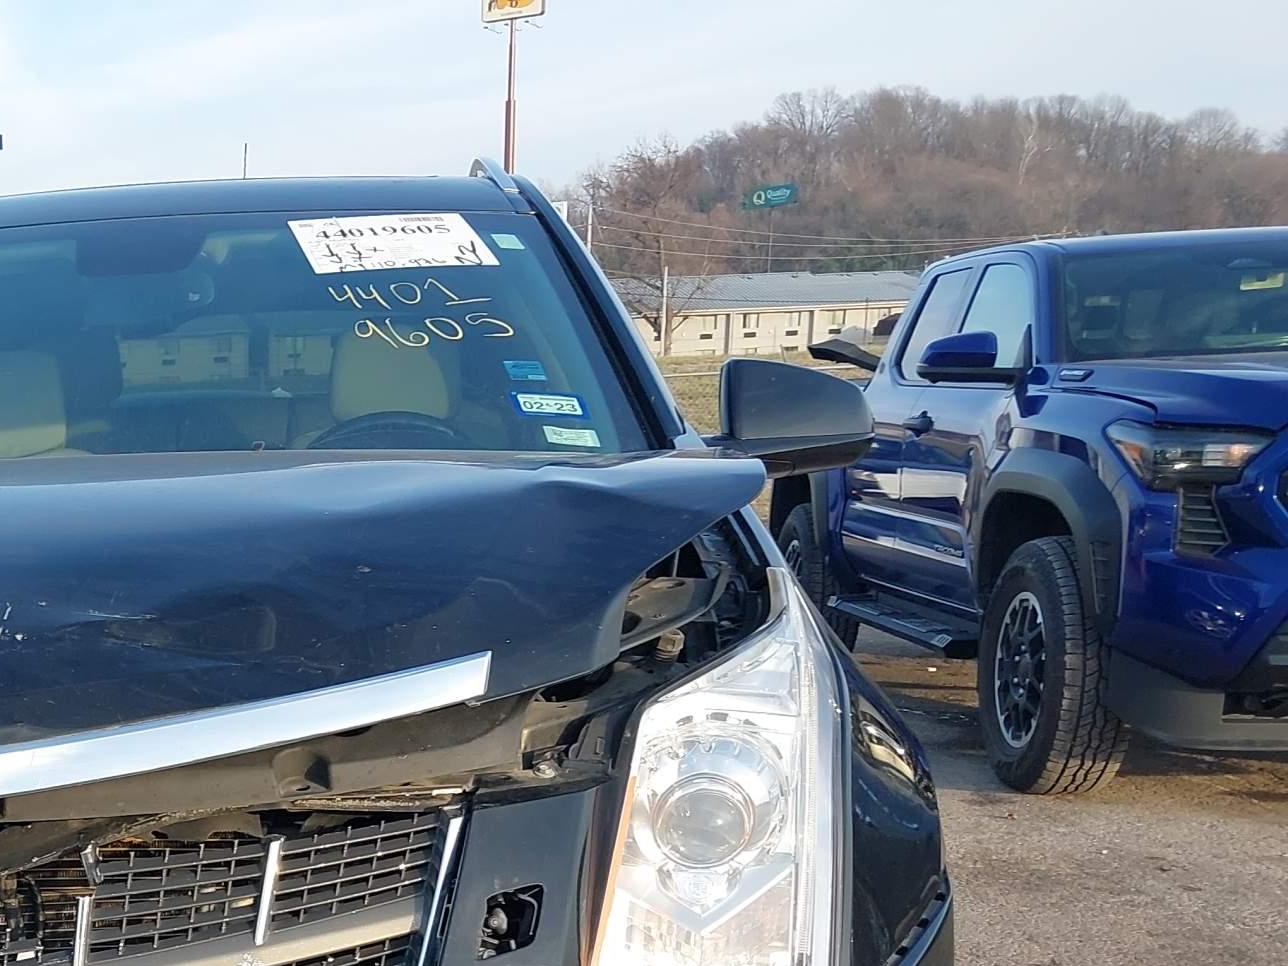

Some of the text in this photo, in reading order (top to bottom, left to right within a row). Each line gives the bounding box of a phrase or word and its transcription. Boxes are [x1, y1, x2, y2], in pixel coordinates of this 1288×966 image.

[315, 223, 451, 239] 44019605
[327, 277, 493, 311] 4401
[354, 312, 515, 349] 9605
